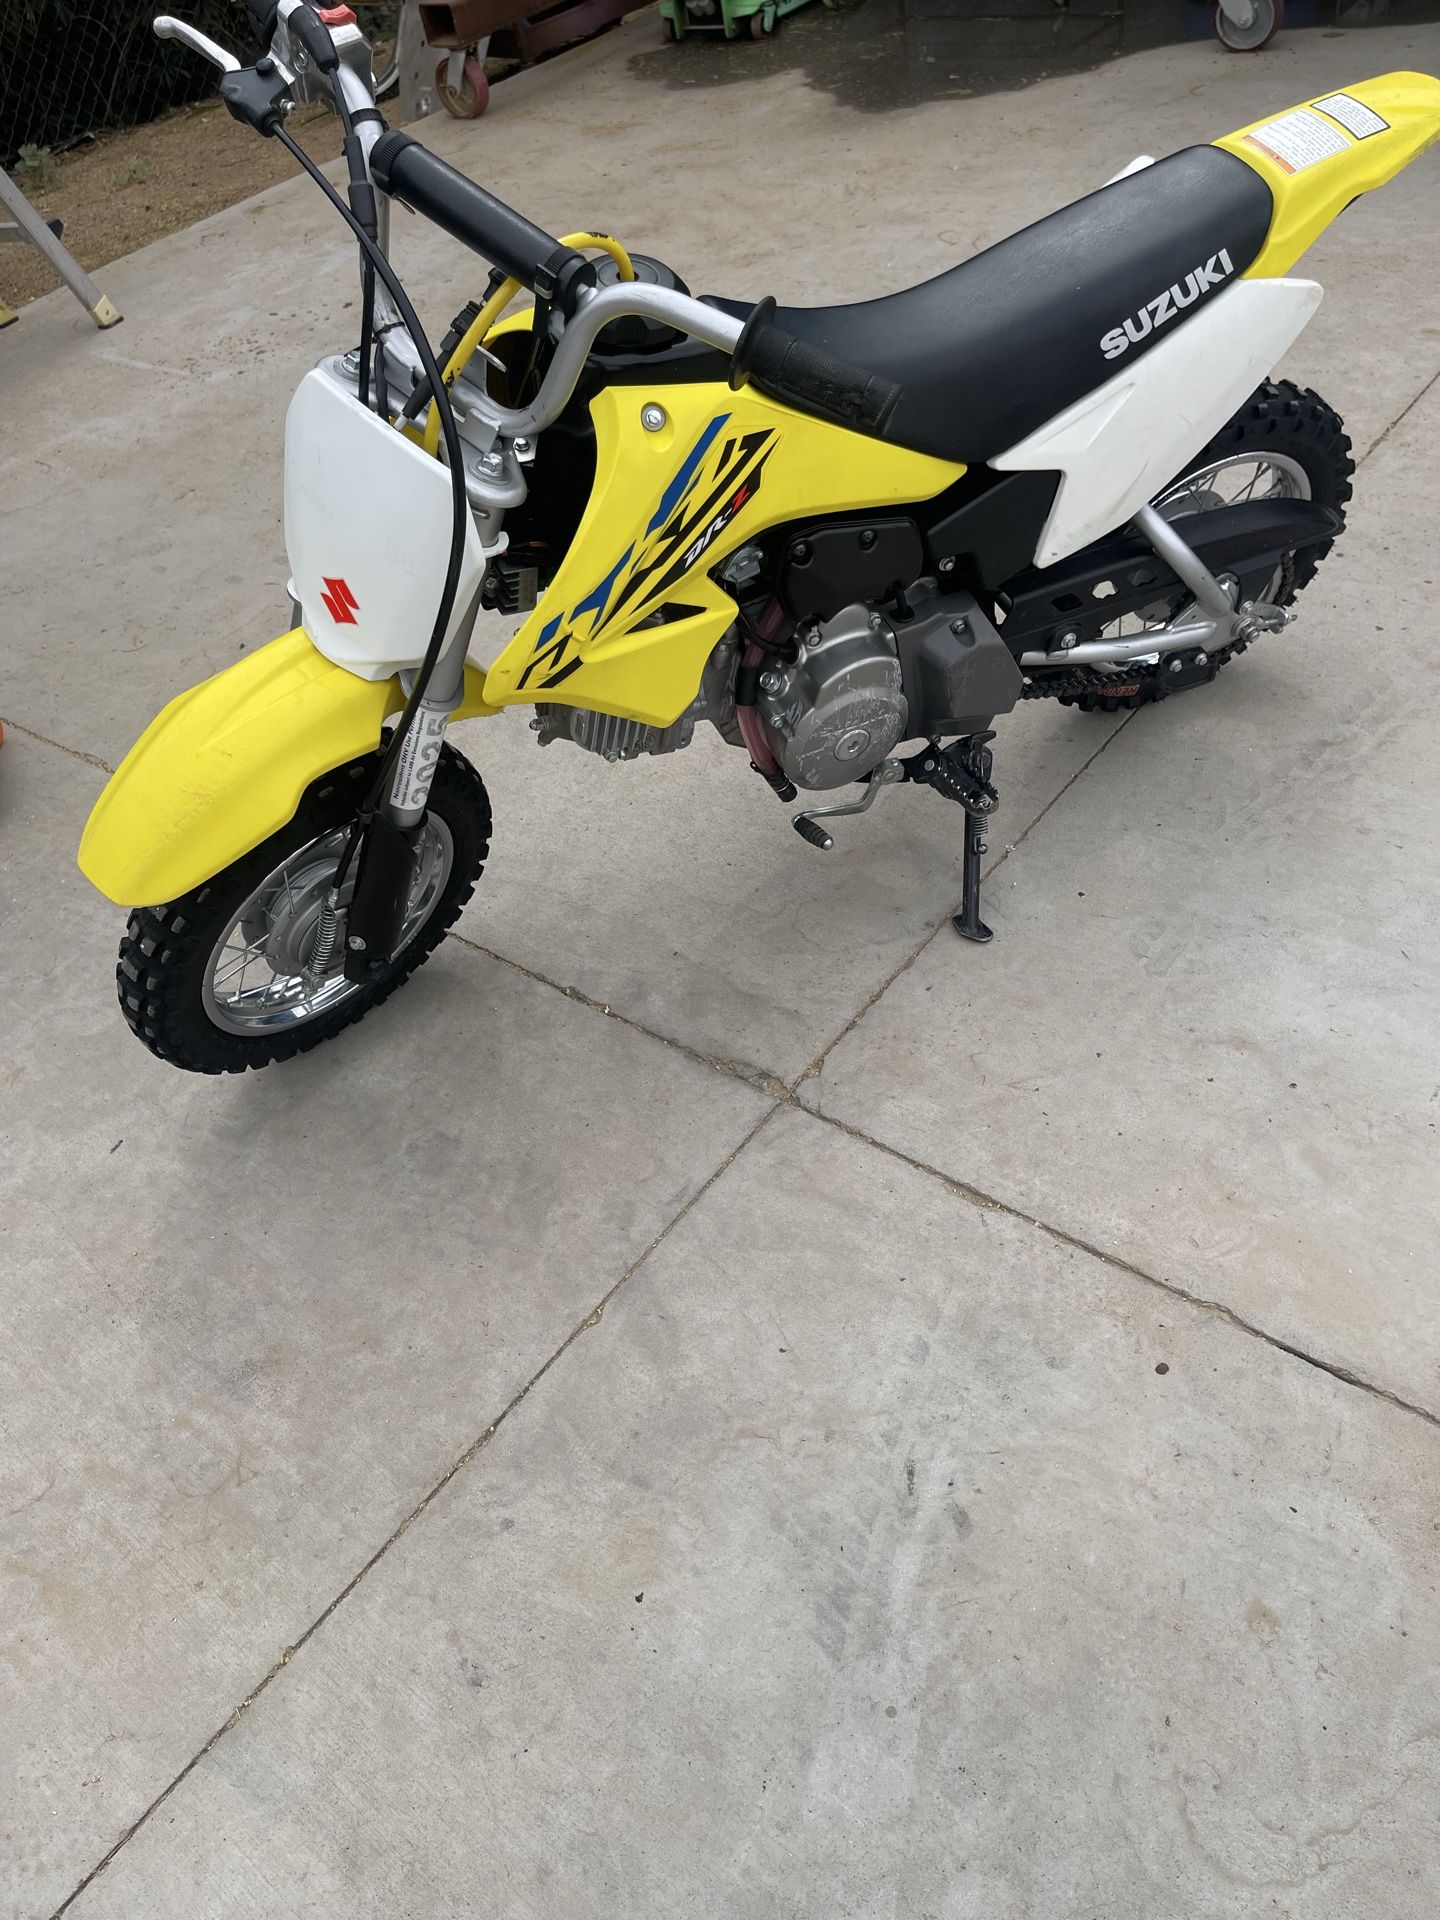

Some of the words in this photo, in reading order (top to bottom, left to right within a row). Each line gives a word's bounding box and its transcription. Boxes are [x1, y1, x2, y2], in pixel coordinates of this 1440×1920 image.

[1100, 248, 1234, 360] SUZUKI
[404, 735, 412, 748] Use
[411, 735, 420, 754] Emissions
[416, 711, 425, 735] Regulations
[401, 748, 409, 764] OHV
[393, 764, 406, 800] Nonresident
